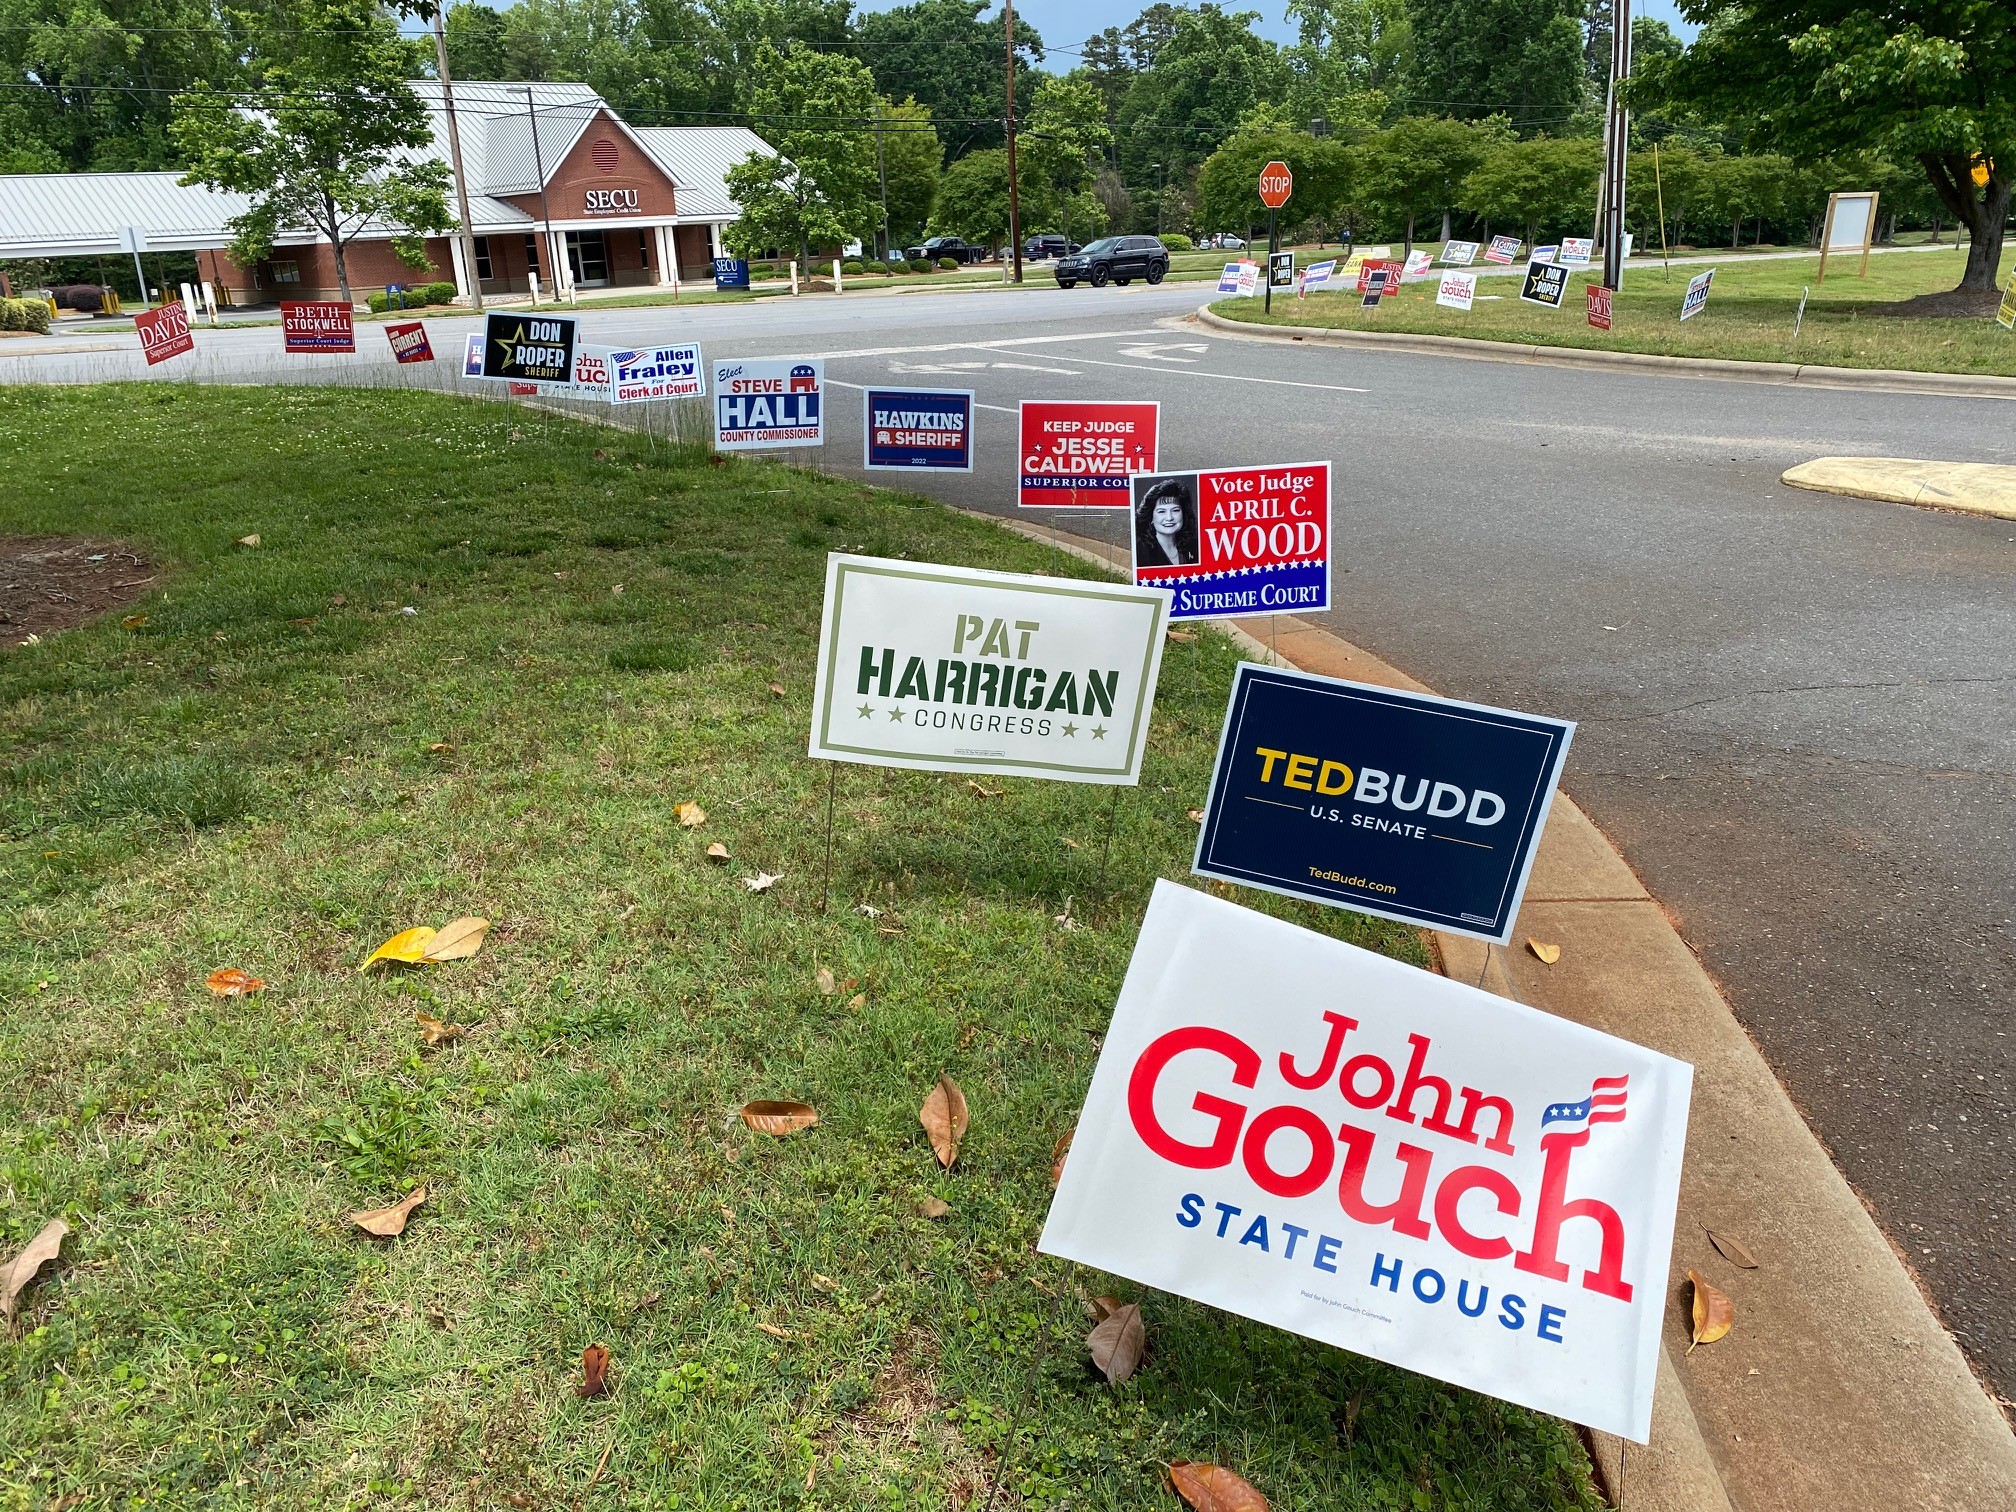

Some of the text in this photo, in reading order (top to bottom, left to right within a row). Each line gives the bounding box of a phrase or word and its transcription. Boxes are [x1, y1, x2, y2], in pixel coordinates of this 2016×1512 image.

[1261, 176, 1290, 193] STOP
[586, 189, 638, 209] SECU
[1562, 247, 1591, 255] WORLEY
[716, 259, 738, 272] SECU
[1546, 267, 1562, 281] DON
[1441, 281, 1471, 299] Gouch
[1450, 278, 1465, 287] John
[1536, 281, 1560, 297] ROPER
[1588, 294, 1611, 317] DAVIS
[1684, 286, 1709, 310] HALL
[157, 303, 182, 320] JUSTIN
[294, 306, 340, 318] BETH
[139, 313, 188, 348] DAVIS
[287, 318, 350, 330] STOCKWELL
[530, 321, 561, 342] DON
[150, 338, 188, 358] Superior Court
[391, 328, 425, 354] CURRENT
[515, 345, 565, 368] ROPER
[576, 353, 604, 367] ohn
[655, 350, 694, 362] Allen
[525, 366, 560, 378] SHERIFF
[619, 363, 694, 381] Fraley
[718, 366, 742, 382] Elect
[619, 386, 650, 399] Clerk
[666, 382, 698, 394] Court
[732, 379, 782, 393] STEVE
[720, 396, 817, 428] HALL
[874, 410, 964, 431] HAWKINS
[720, 428, 819, 442] COUNTY COMMISSIONER
[1043, 421, 1135, 433] KEEP JUDGE
[895, 431, 961, 446] SHERIFF
[1051, 438, 1125, 455] JESSE
[1025, 456, 1152, 474] CALDWELL
[1024, 478, 1129, 487] SUPERIOR COU
[1209, 472, 1314, 494] Vote Judge
[1210, 496, 1313, 523] APRIL C.
[1205, 521, 1322, 562] WOOD
[953, 614, 1040, 660] PAT
[856, 645, 1119, 717] HARRIGAN
[914, 709, 1052, 736] CONGRESS
[1310, 805, 1427, 840] U.S. SENATE
[1309, 866, 1397, 894] TedBudd.com
[1278, 1010, 1516, 1157] John
[1127, 1025, 1634, 1304] Gouch
[1176, 1192, 1567, 1345] STATE HOUSE
[1300, 1290, 1313, 1299] Paid
[1322, 1296, 1329, 1304] by
[1328, 1299, 1342, 1308] John
[1342, 1303, 1361, 1314] Gouch
[1361, 1309, 1392, 1324] Committee
